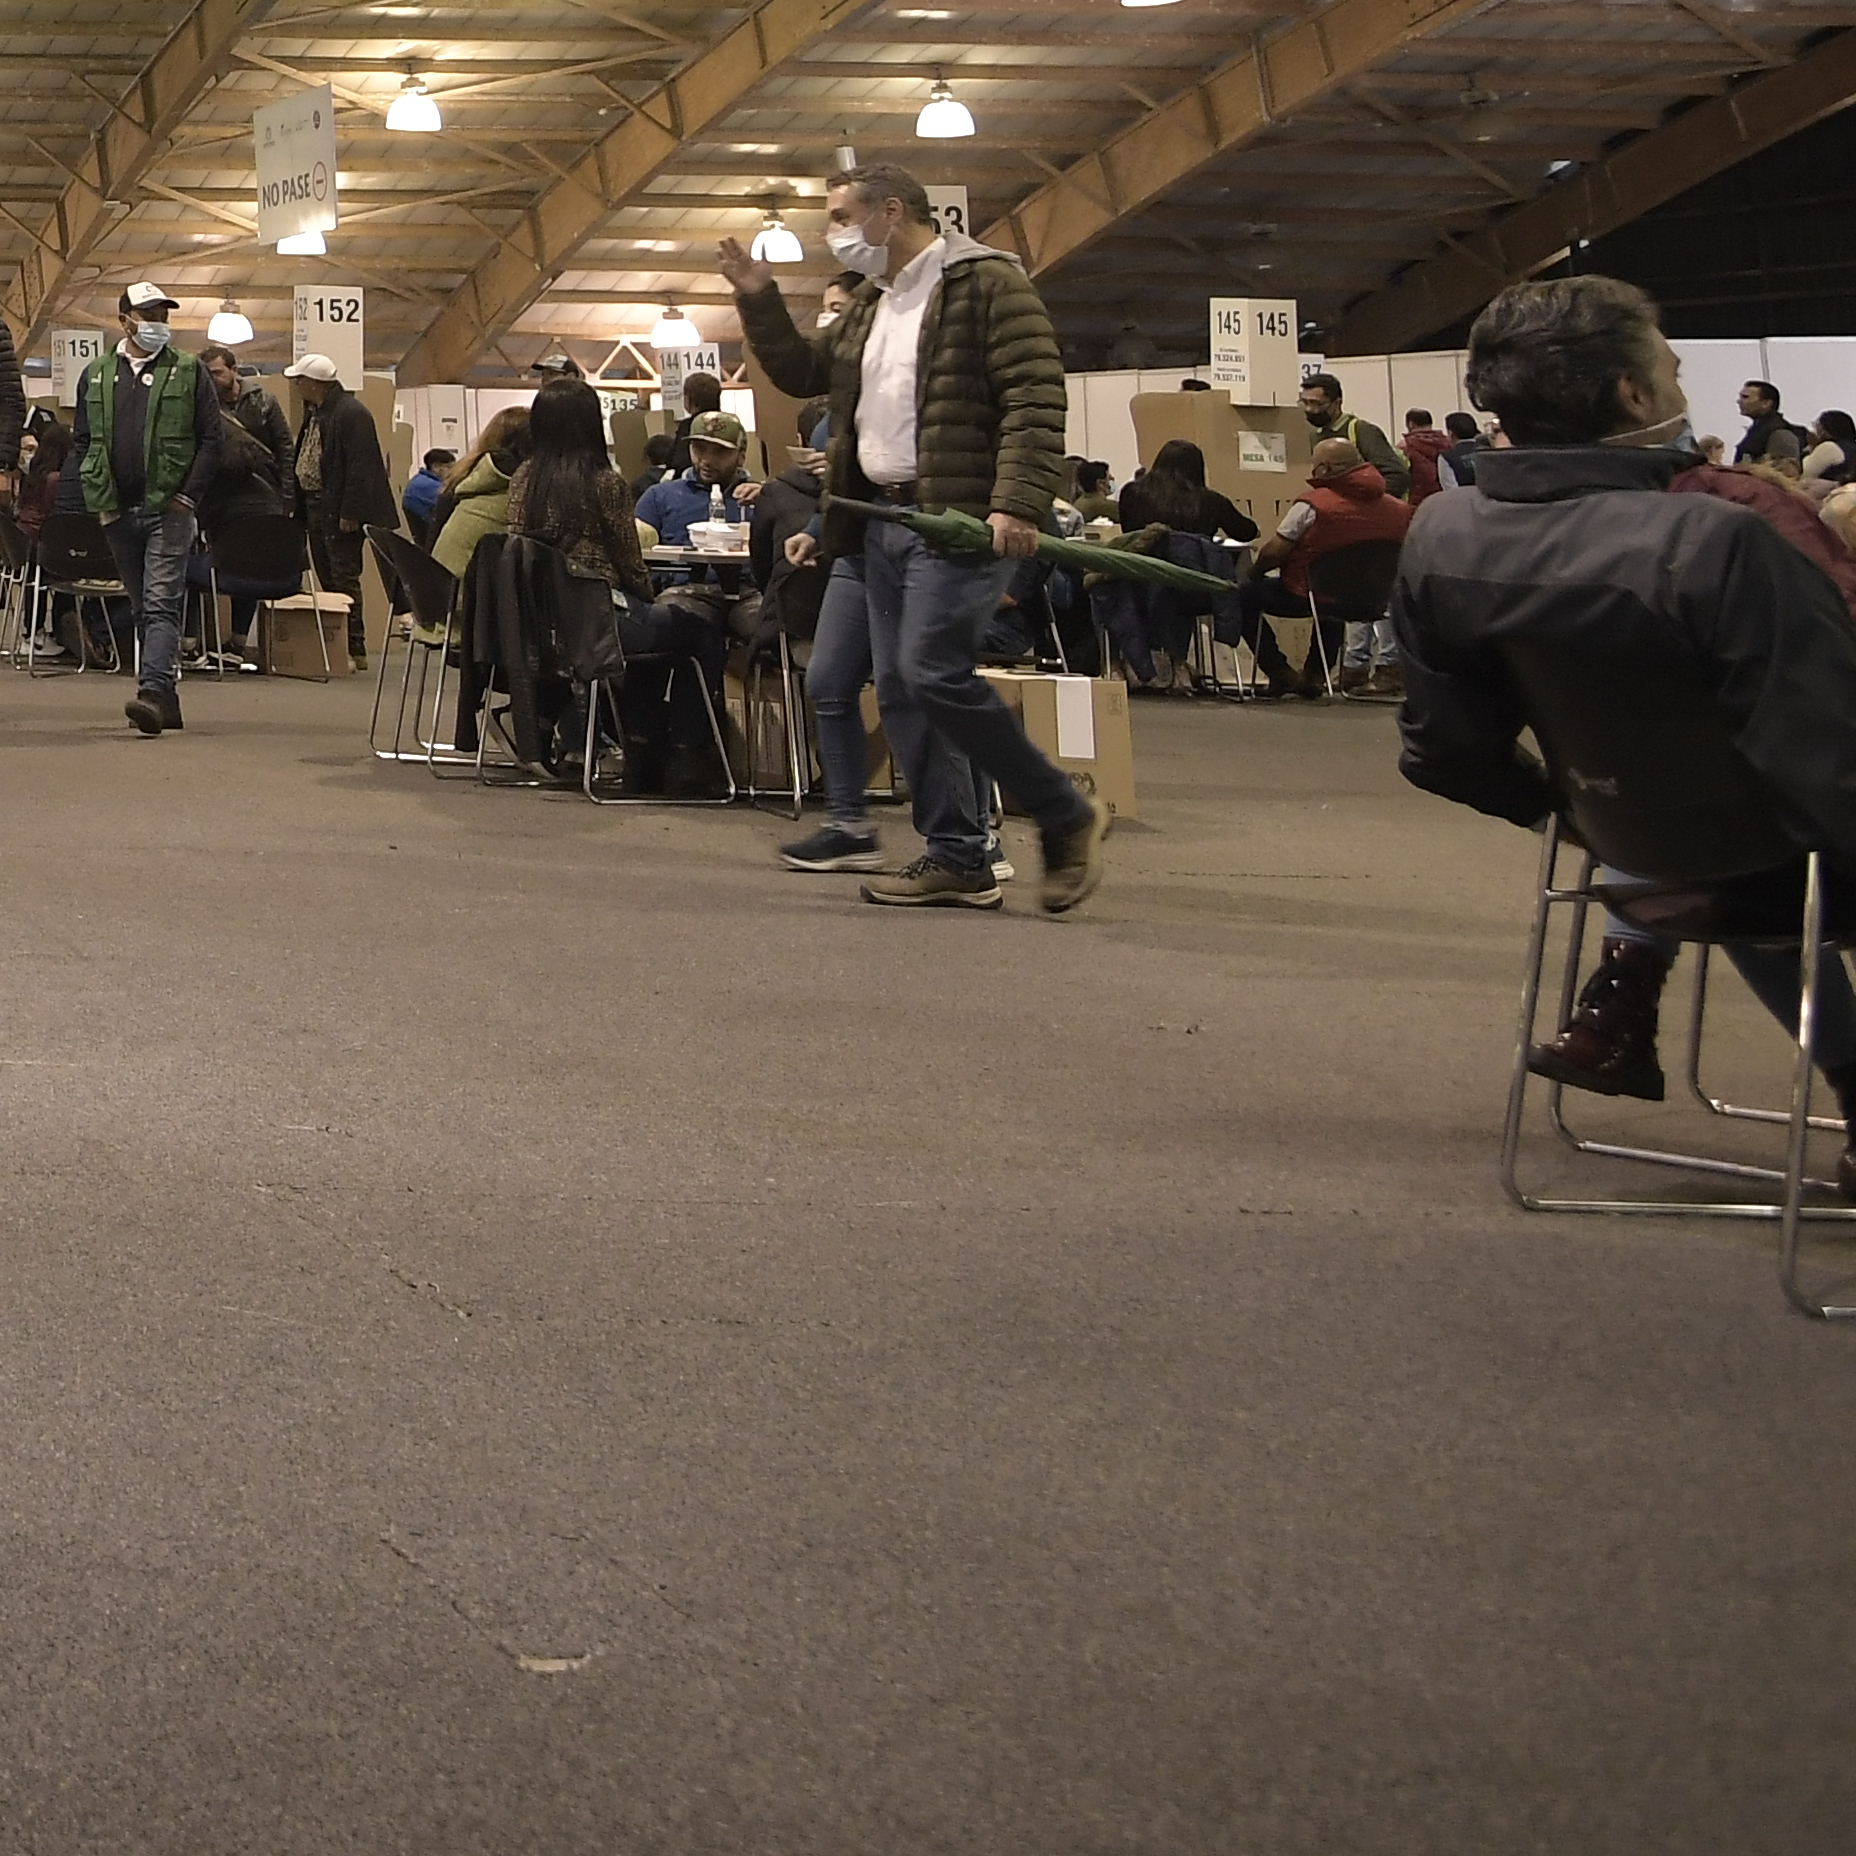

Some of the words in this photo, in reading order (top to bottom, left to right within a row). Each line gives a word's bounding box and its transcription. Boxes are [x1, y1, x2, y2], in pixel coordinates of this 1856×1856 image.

[262, 181, 280, 210] NO
[282, 172, 311, 204] PASE
[928, 205, 965, 235] 53
[295, 296, 308, 321] 152
[313, 297, 360, 323] 152
[1217, 310, 1241, 336] 145
[1256, 311, 1288, 337] 145
[68, 338, 99, 358] 151
[682, 350, 717, 371] 144
[660, 352, 680, 371] 144
[1301, 363, 1322, 382] 37
[609, 397, 639, 411] 135
